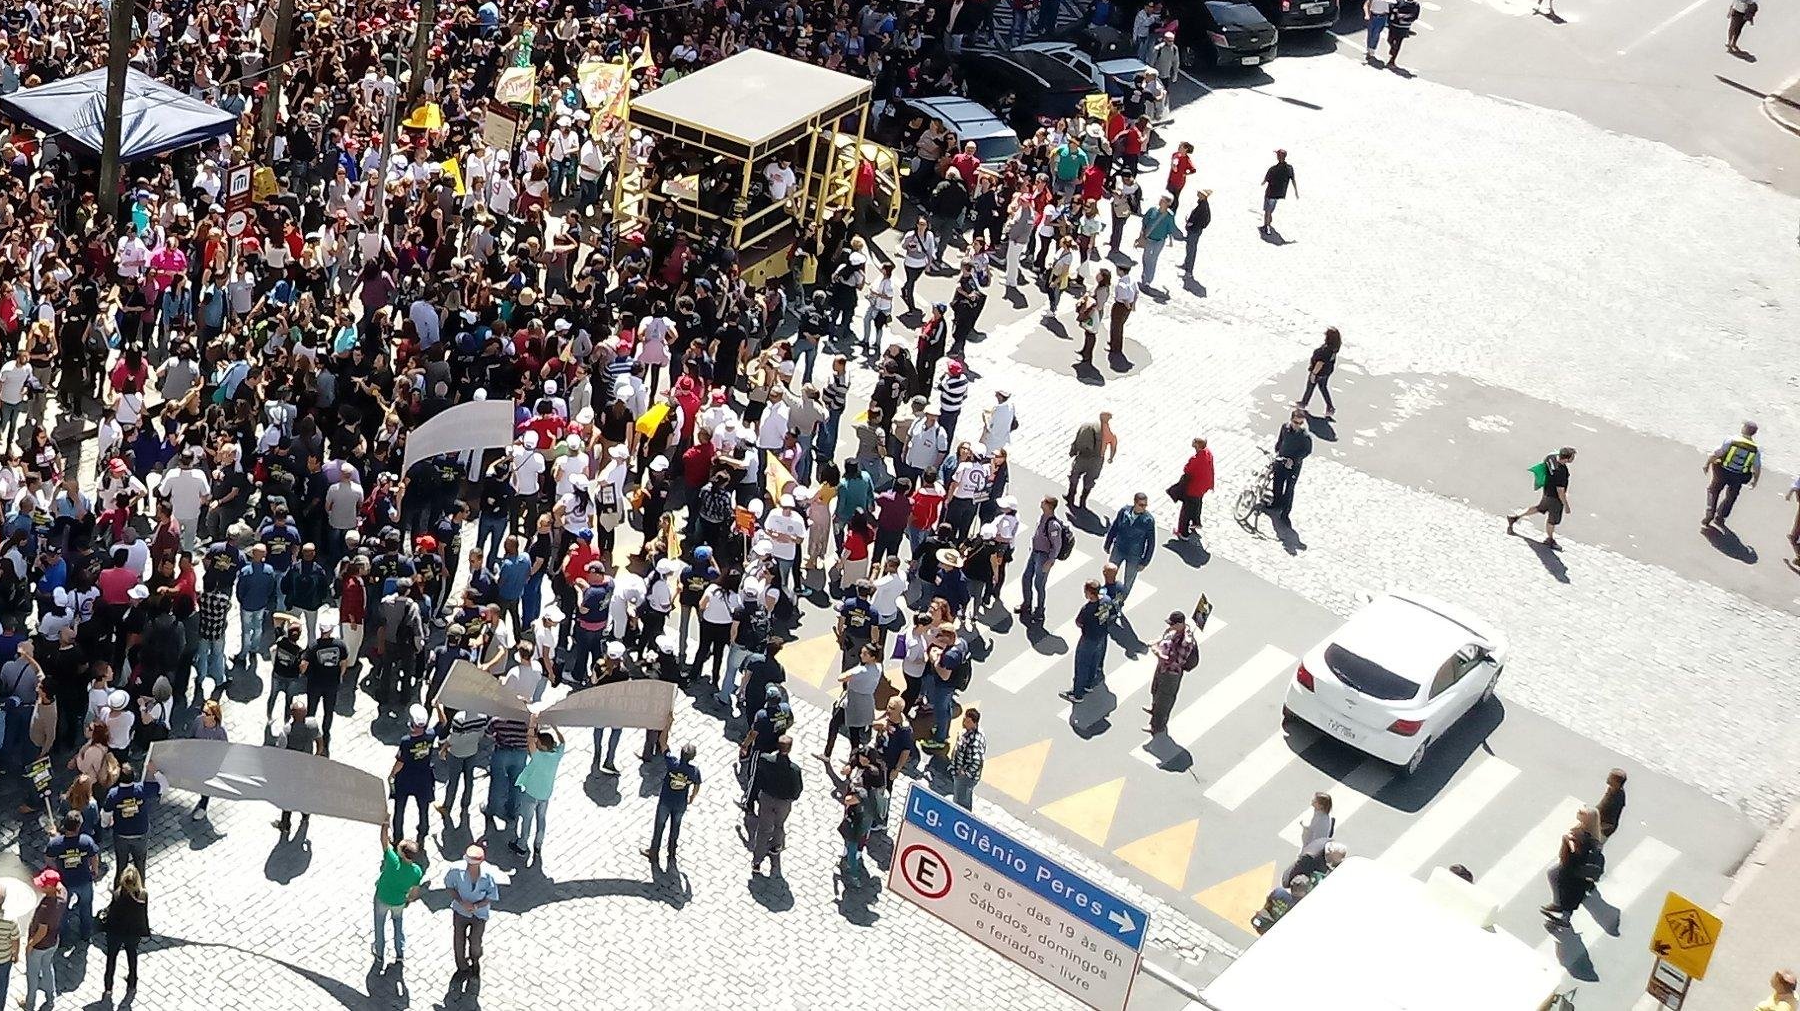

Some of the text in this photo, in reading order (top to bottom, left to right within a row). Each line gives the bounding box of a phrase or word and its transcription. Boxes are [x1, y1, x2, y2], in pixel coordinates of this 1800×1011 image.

[912, 796, 1103, 916] Lg. Glênio Peres
[916, 854, 938, 889] E
[969, 892, 1108, 980] Sábados, domingos
[976, 919, 985, 929] e
[989, 924, 1047, 965] feriados
[1059, 965, 1091, 991] livre
[983, 882, 992, 892] a
[1026, 905, 1052, 927] das
[1058, 921, 1076, 939] 19
[1080, 935, 1098, 953] às
[1103, 948, 1124, 968] 6h
